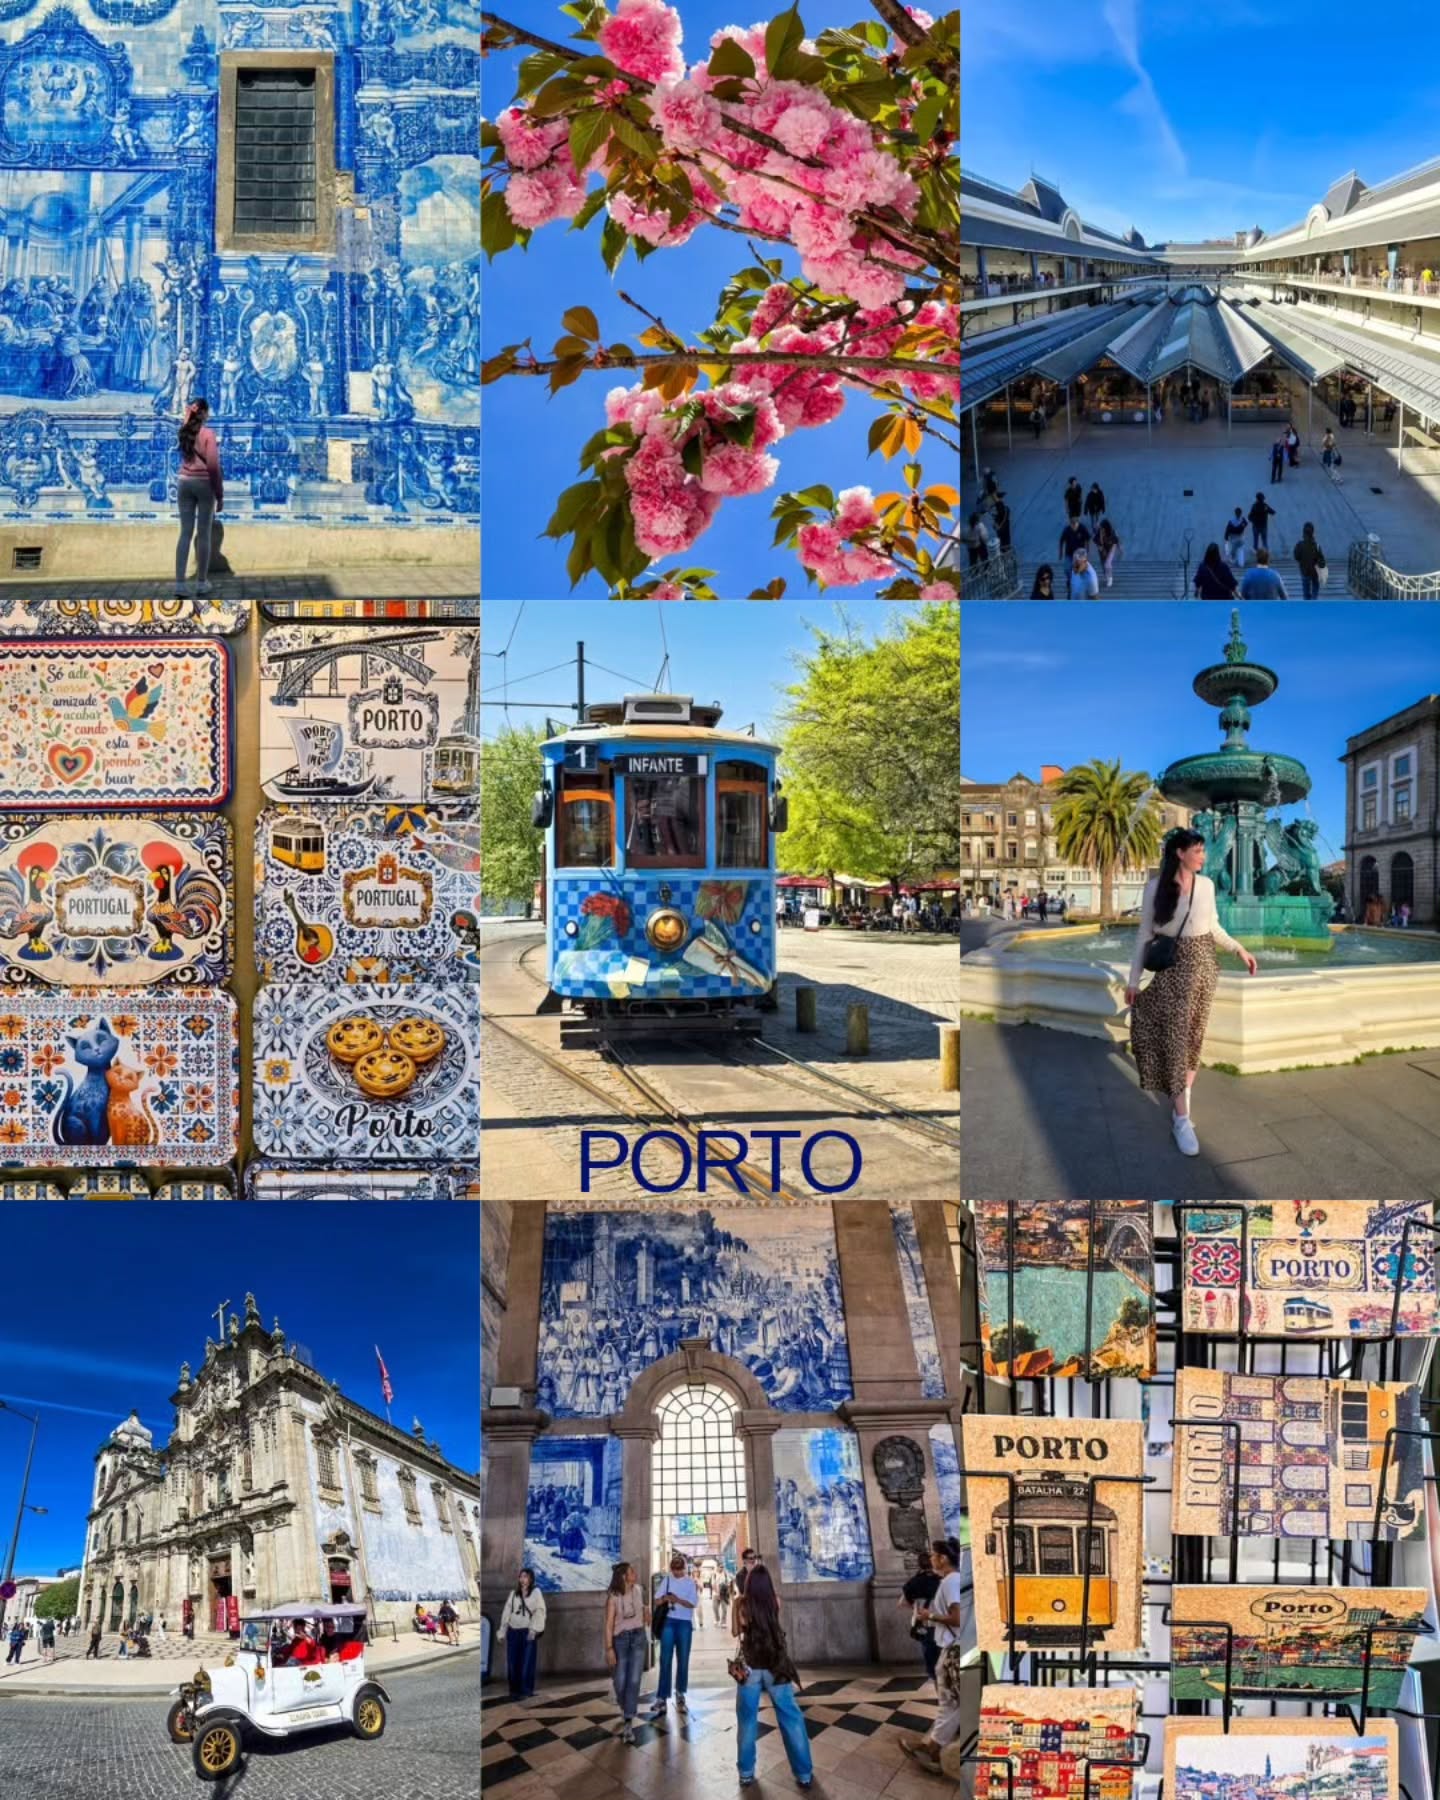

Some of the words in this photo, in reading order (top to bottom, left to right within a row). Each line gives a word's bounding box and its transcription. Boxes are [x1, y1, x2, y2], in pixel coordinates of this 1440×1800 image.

[52, 693, 97, 707] amizade
[362, 709, 423, 732] PORTO
[105, 736, 129, 749] esta
[574, 746, 587, 768] 1
[628, 757, 684, 773] INFANTE
[105, 770, 135, 785] buar
[68, 898, 131, 915] PORTUGAL
[356, 889, 419, 907] PORTUGAL
[334, 1102, 435, 1139] Porto
[1271, 1259, 1351, 1278] PORTO
[993, 1435, 1109, 1461] PORTO
[1017, 1486, 1064, 1496] BATALHA
[1264, 1601, 1333, 1615] Porto
